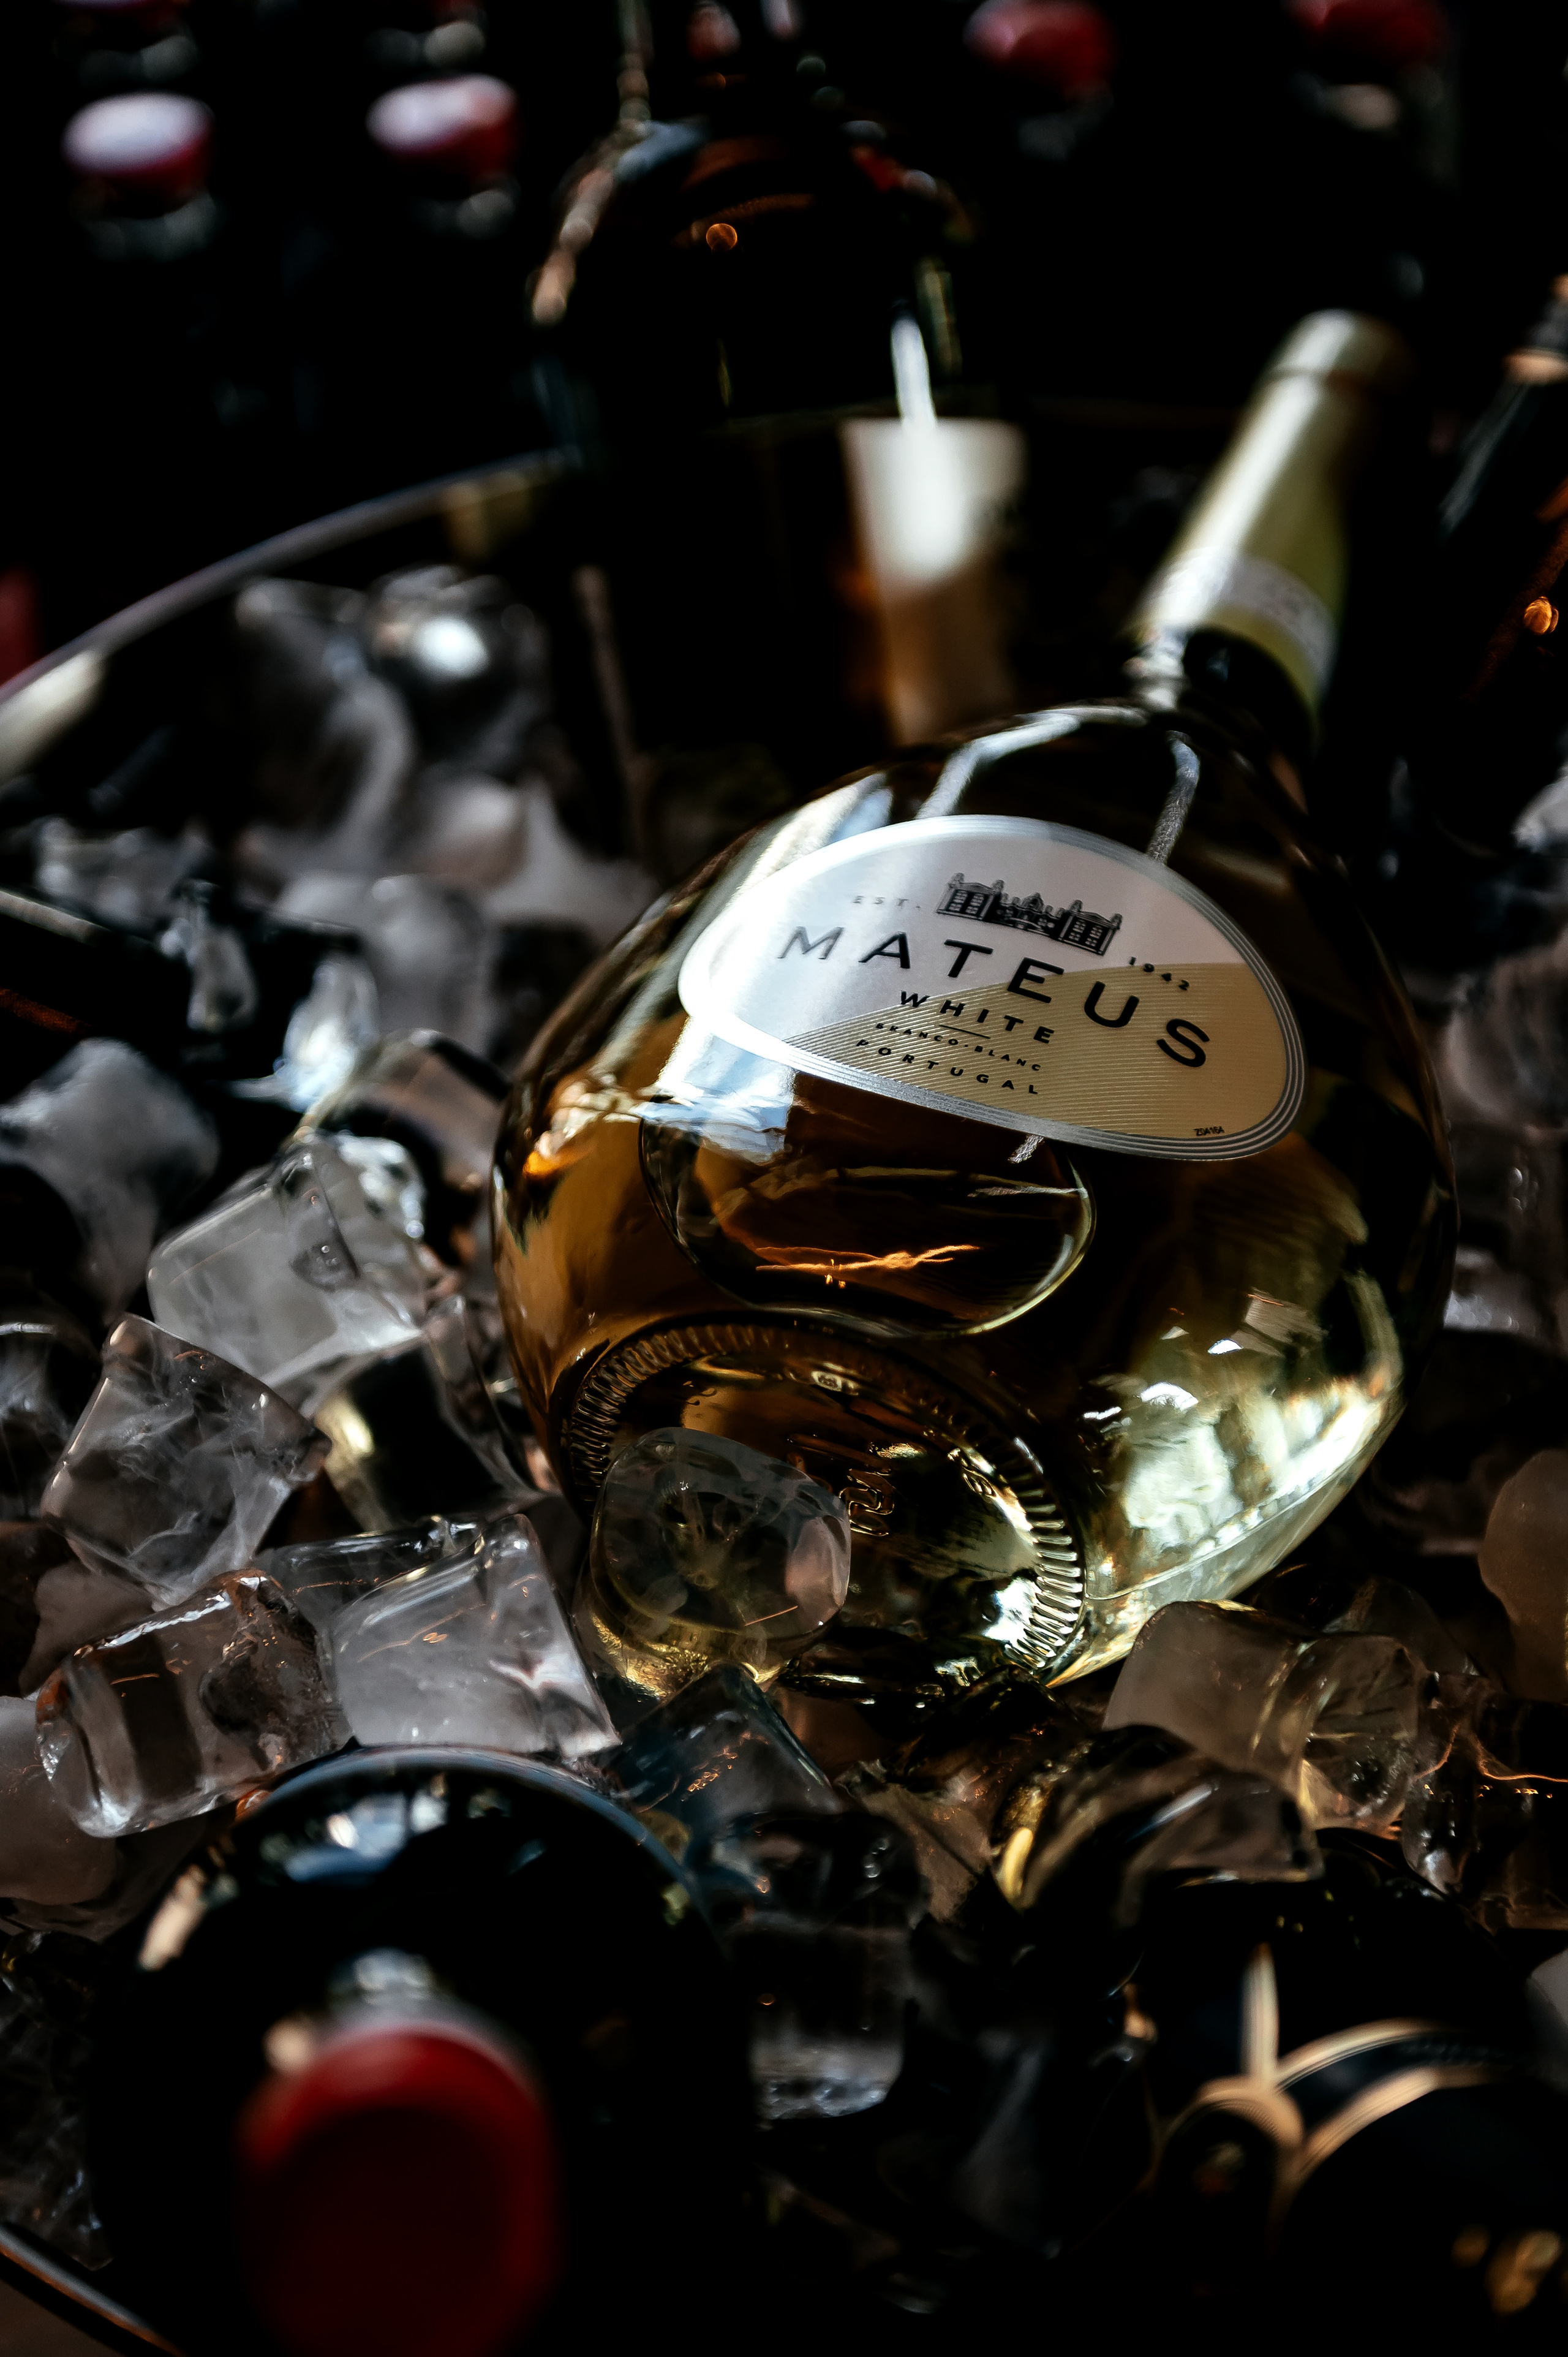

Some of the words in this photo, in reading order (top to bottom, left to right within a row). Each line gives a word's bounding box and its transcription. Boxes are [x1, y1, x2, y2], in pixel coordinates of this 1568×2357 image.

[852, 895, 921, 909] EST.
[777, 926, 1210, 1068] MATEUS
[1129, 956, 1190, 991] 1942
[900, 990, 1055, 1043] WHITE
[855, 1039, 1038, 1094] PORTUGAL
